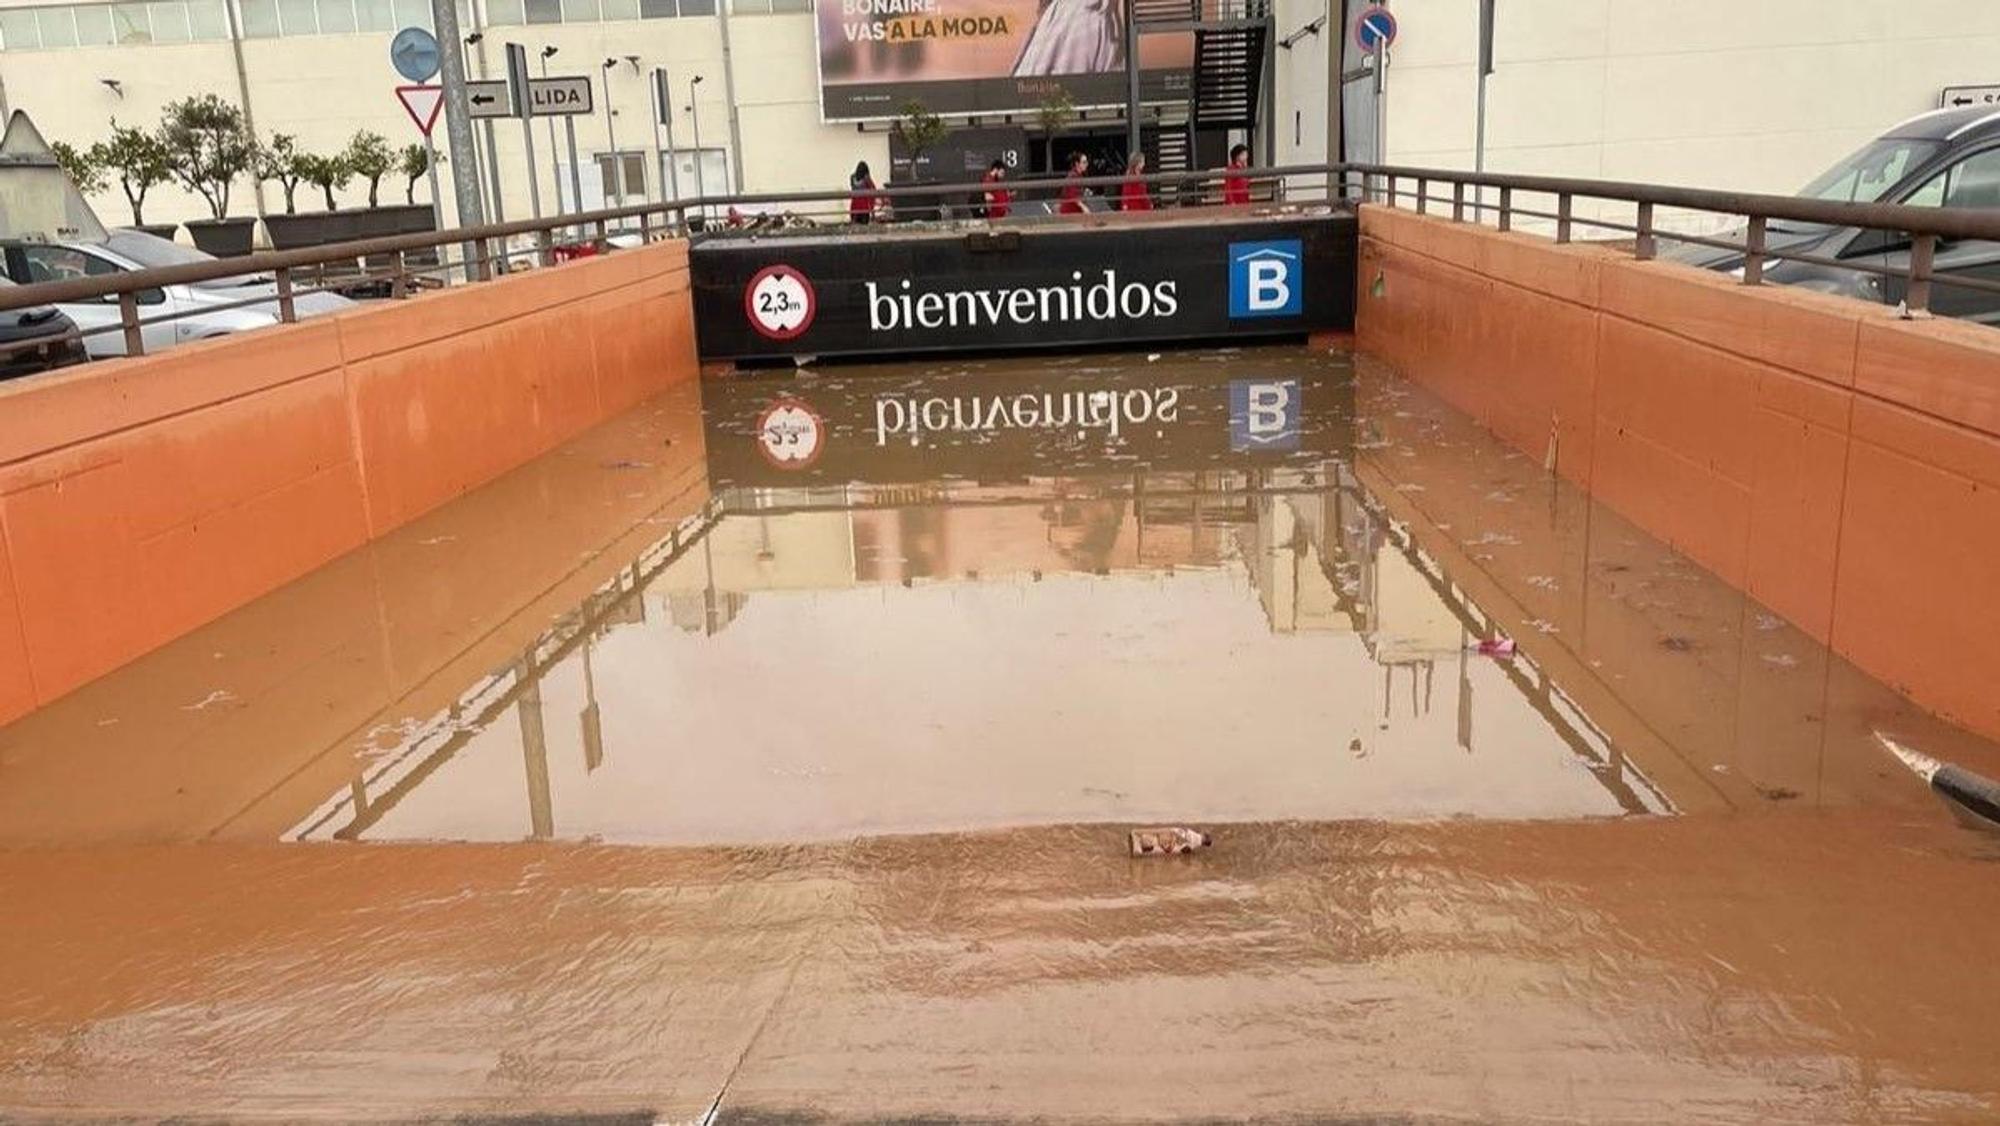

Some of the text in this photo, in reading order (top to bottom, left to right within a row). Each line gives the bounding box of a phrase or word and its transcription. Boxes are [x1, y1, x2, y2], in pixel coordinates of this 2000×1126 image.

[843, 16, 1008, 41] VAS A LA MODA
[534, 88, 581, 105] LIDA
[864, 269, 1178, 331] bienvenidos
[1249, 260, 1290, 310] B
